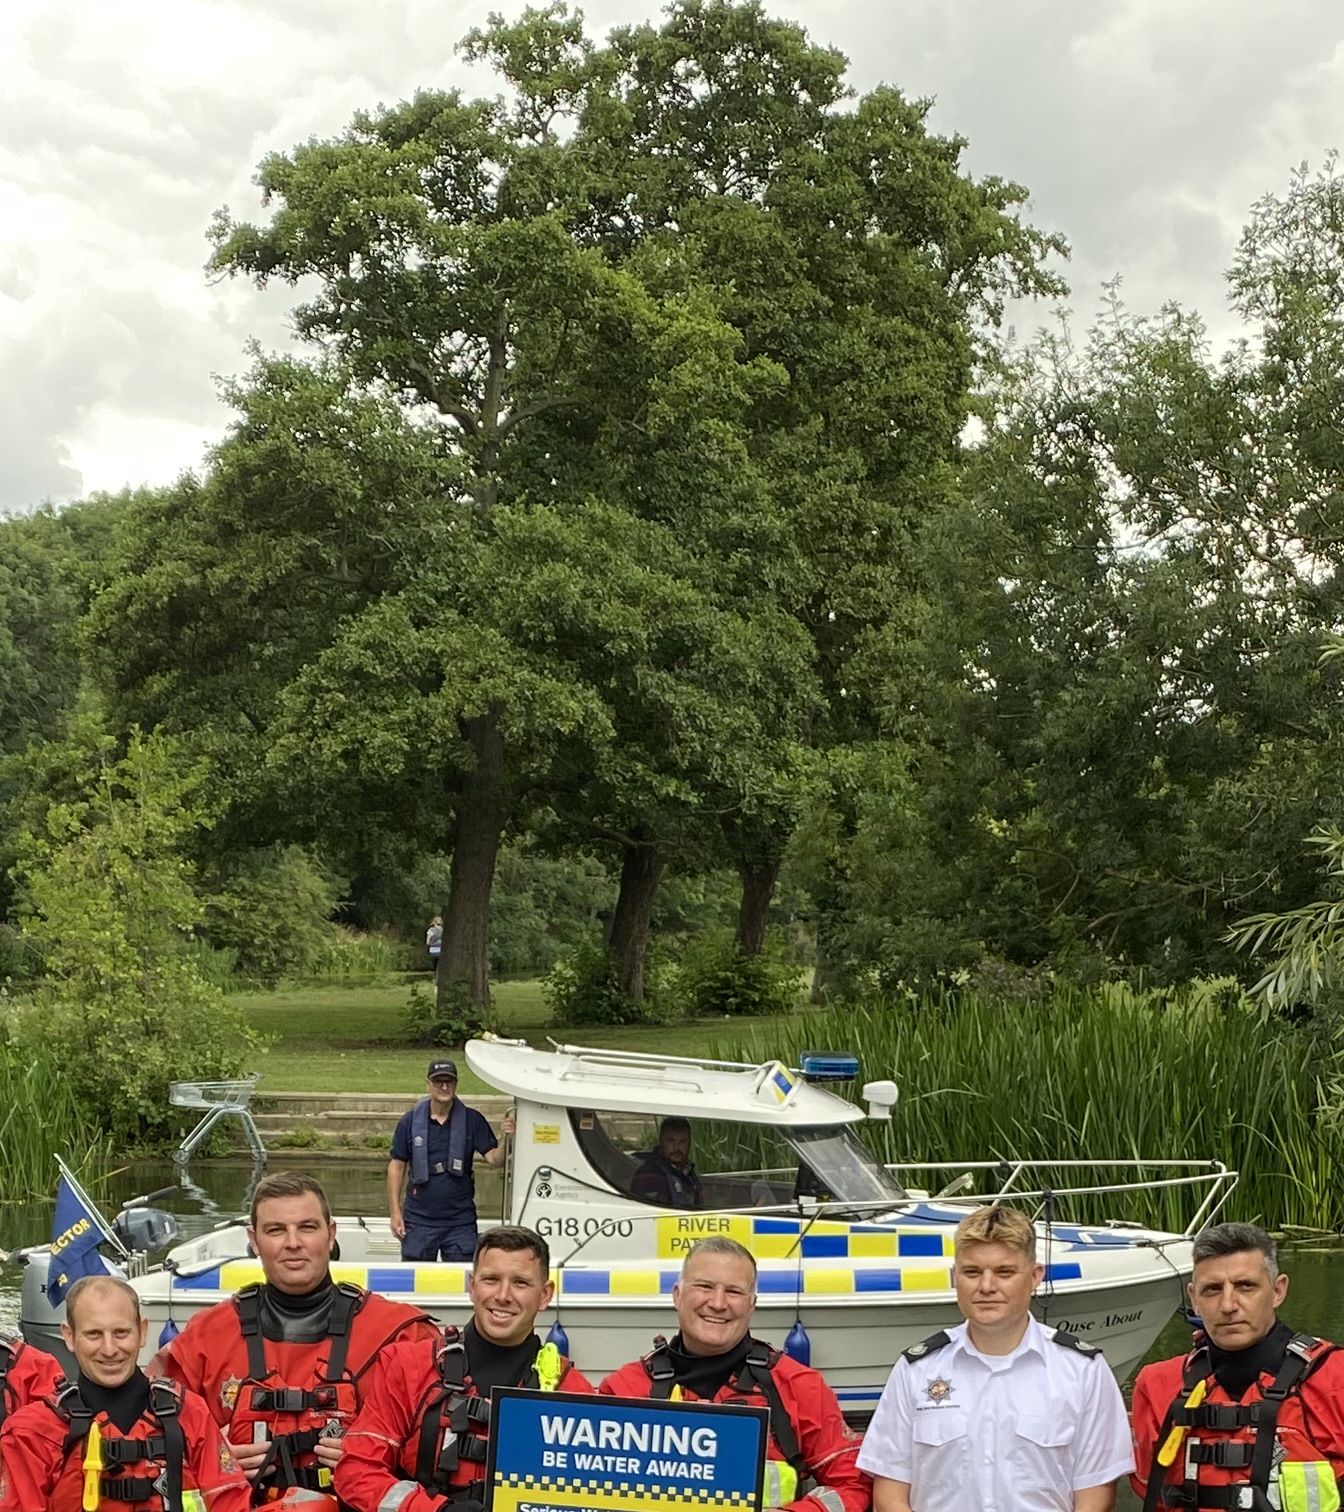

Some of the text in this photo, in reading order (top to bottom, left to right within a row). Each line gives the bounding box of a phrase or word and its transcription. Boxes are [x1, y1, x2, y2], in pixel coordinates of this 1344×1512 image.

[536, 1216, 633, 1238] G18 000
[678, 1217, 730, 1232] RIVER
[670, 1237, 700, 1252] PAT
[1056, 1310, 1143, 1333] Ouse About
[540, 1415, 718, 1458] WARNING
[542, 1451, 715, 1480] BE WATER AWARE
